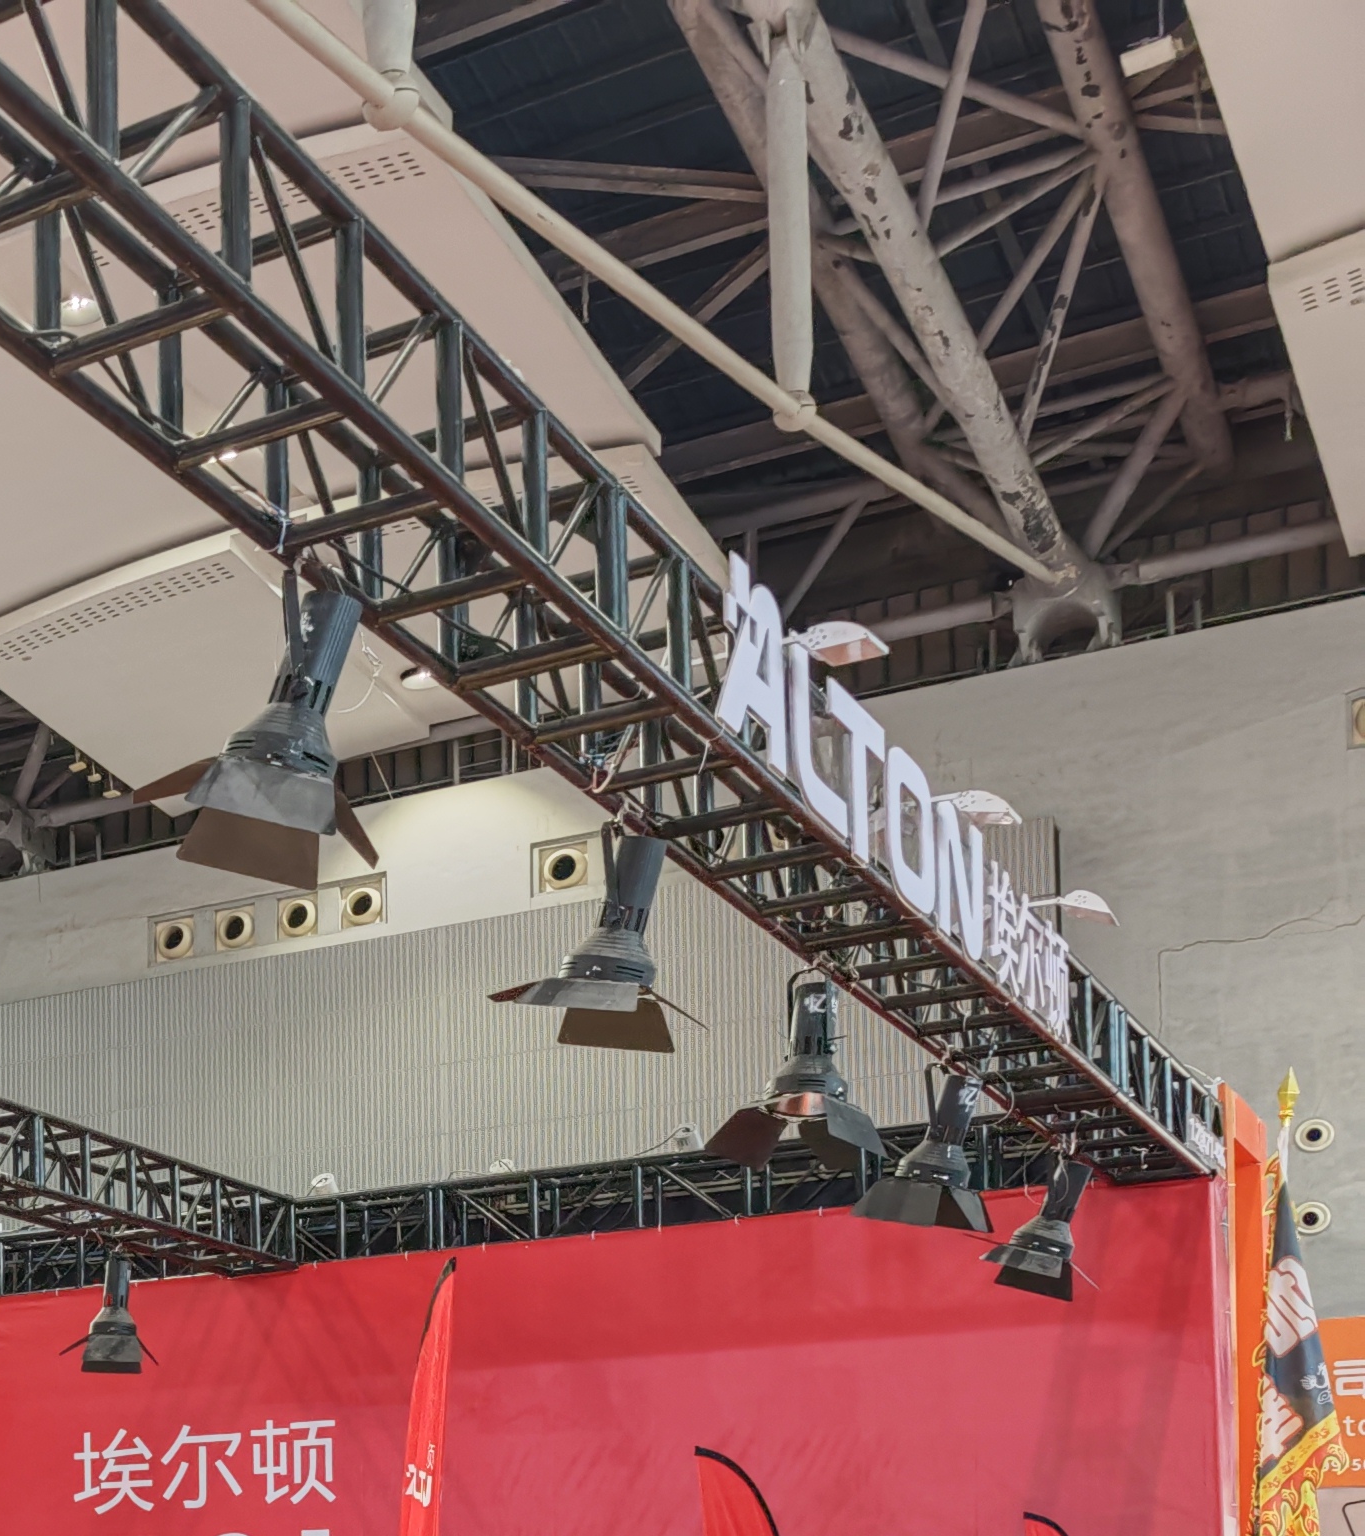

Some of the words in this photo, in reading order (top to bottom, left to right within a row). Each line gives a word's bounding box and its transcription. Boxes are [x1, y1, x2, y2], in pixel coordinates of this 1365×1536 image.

[715, 551, 986, 961] ALTON
[989, 861, 1072, 1044] 埃尔顿
[73, 1418, 336, 1516] 埃尔顿
